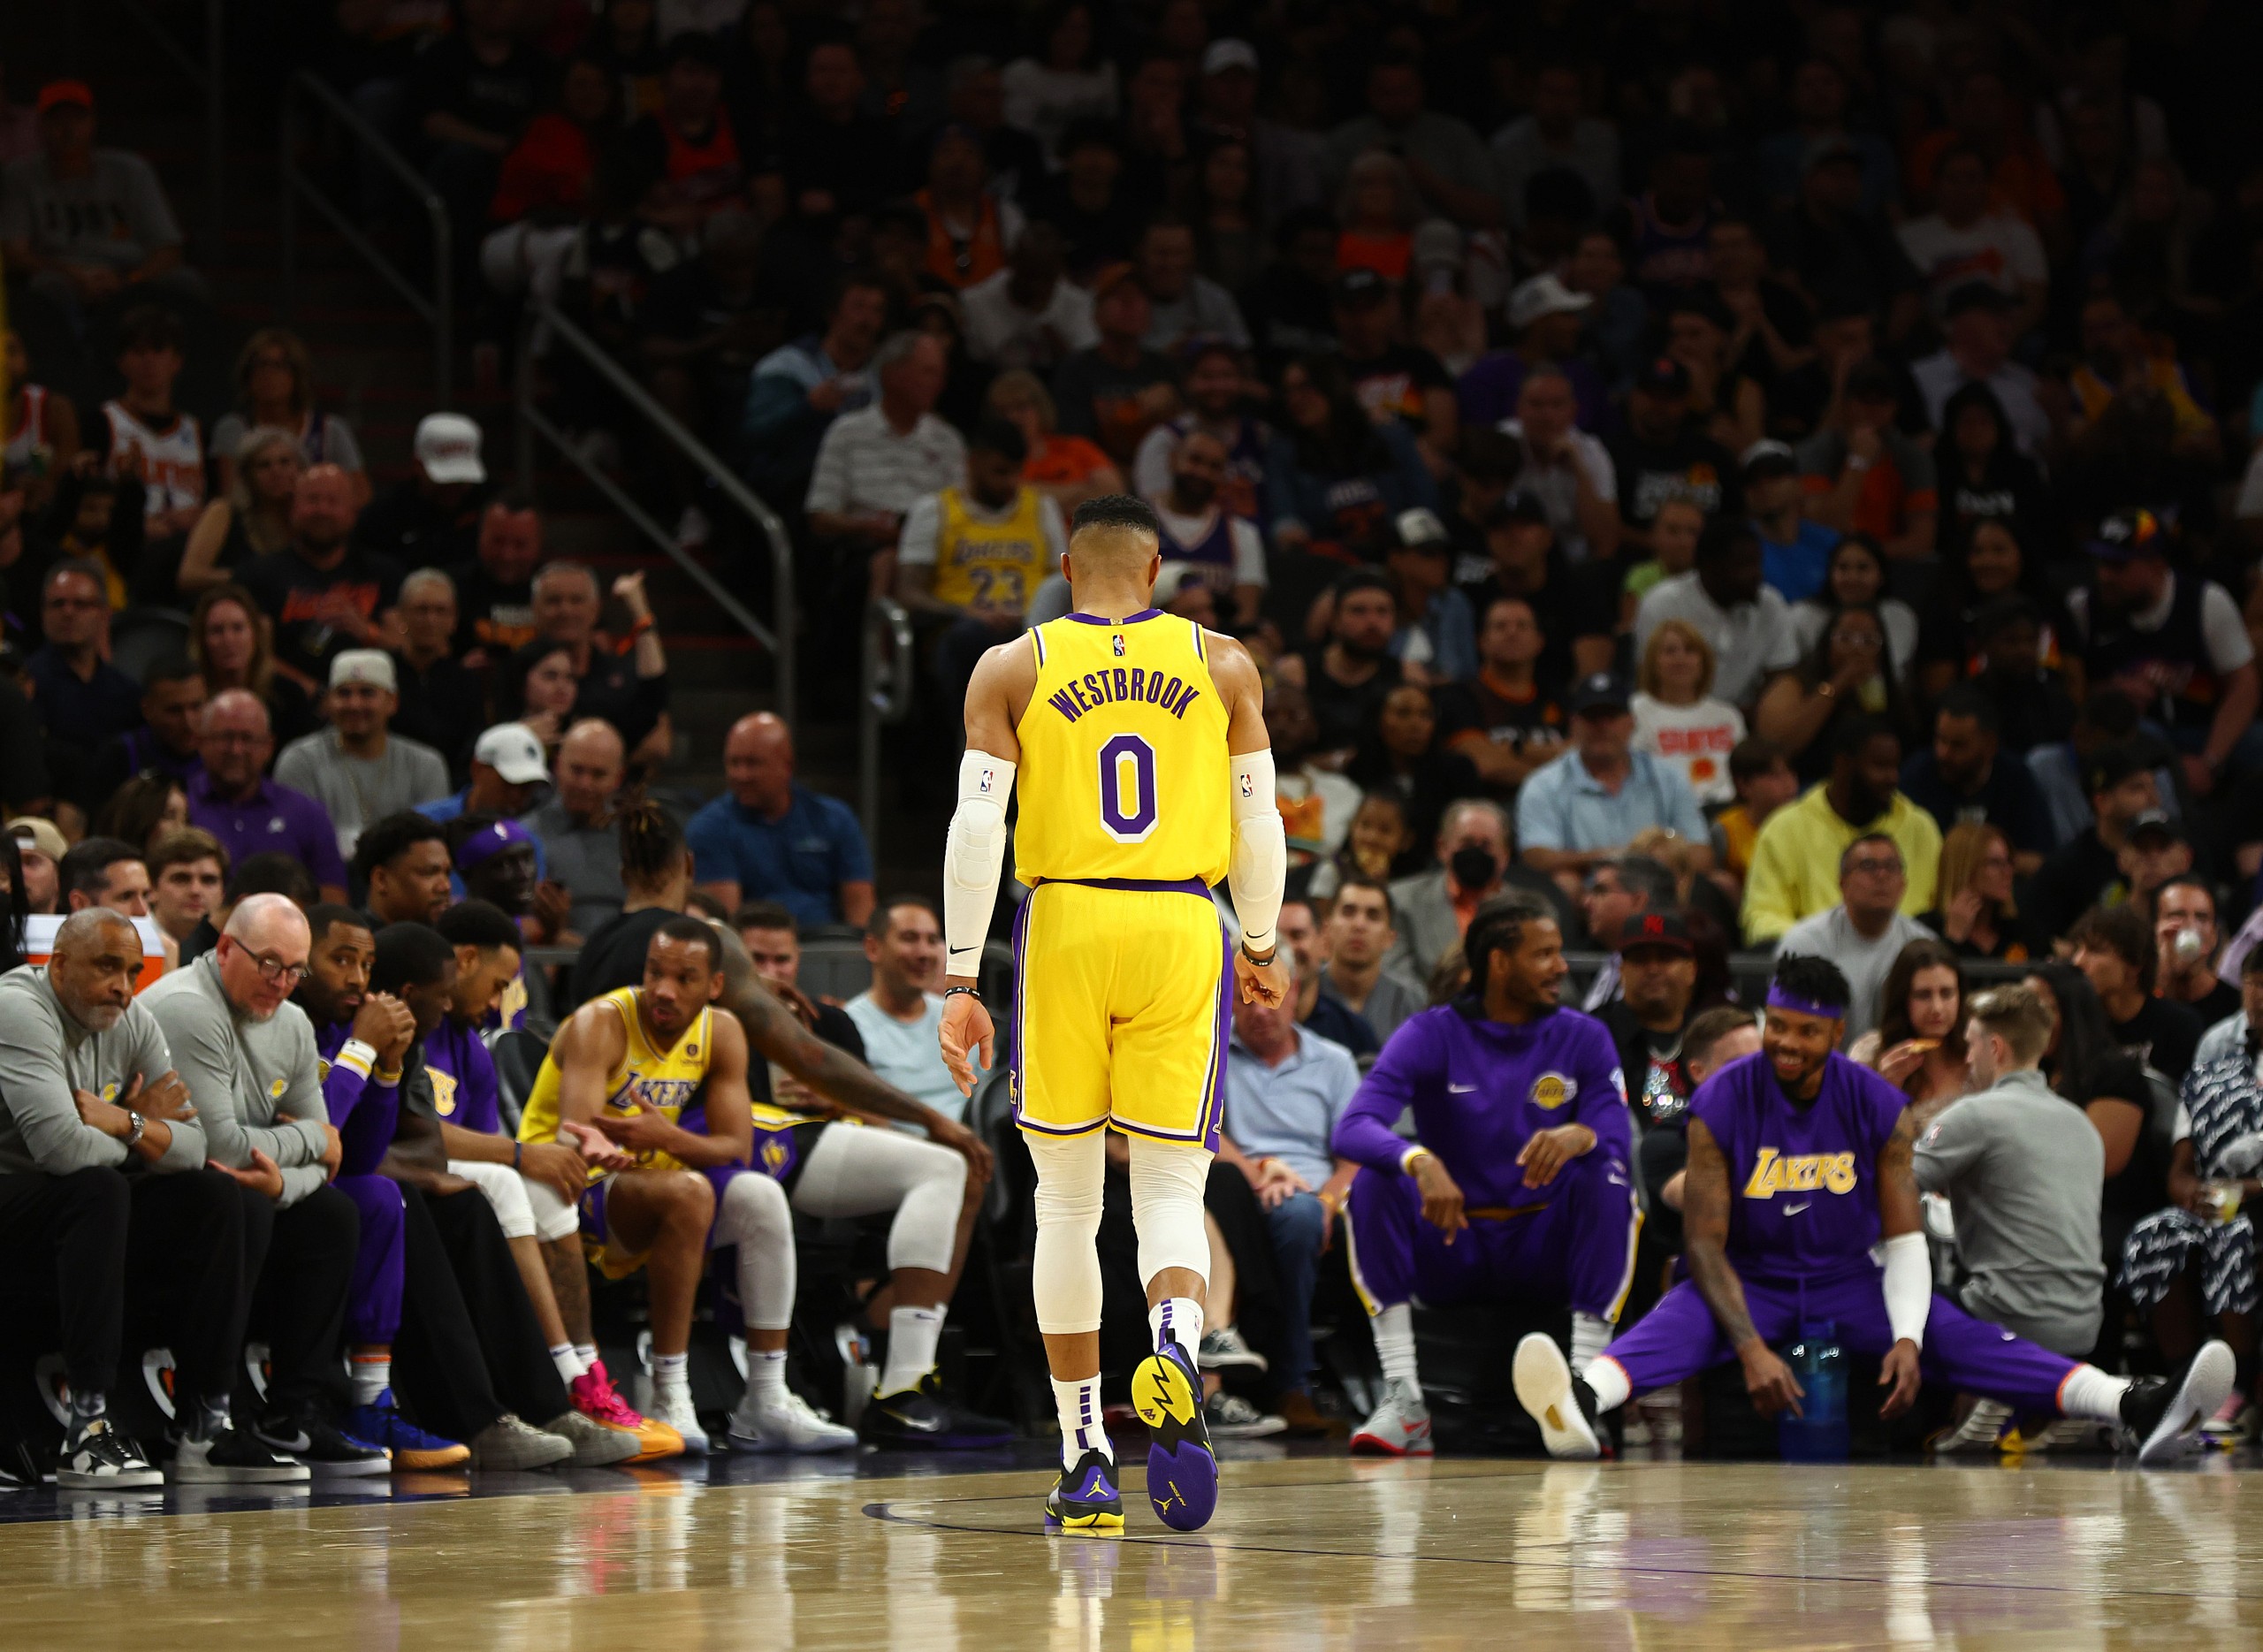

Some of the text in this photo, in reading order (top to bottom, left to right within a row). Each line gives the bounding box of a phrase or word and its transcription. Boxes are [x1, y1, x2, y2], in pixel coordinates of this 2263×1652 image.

[969, 567, 1023, 610] 23
[1048, 668, 1200, 723] WESTBROOK
[1097, 733, 1159, 843] 0
[607, 1071, 698, 1111] LKERS
[1743, 1146, 1857, 1199] LAKERS
